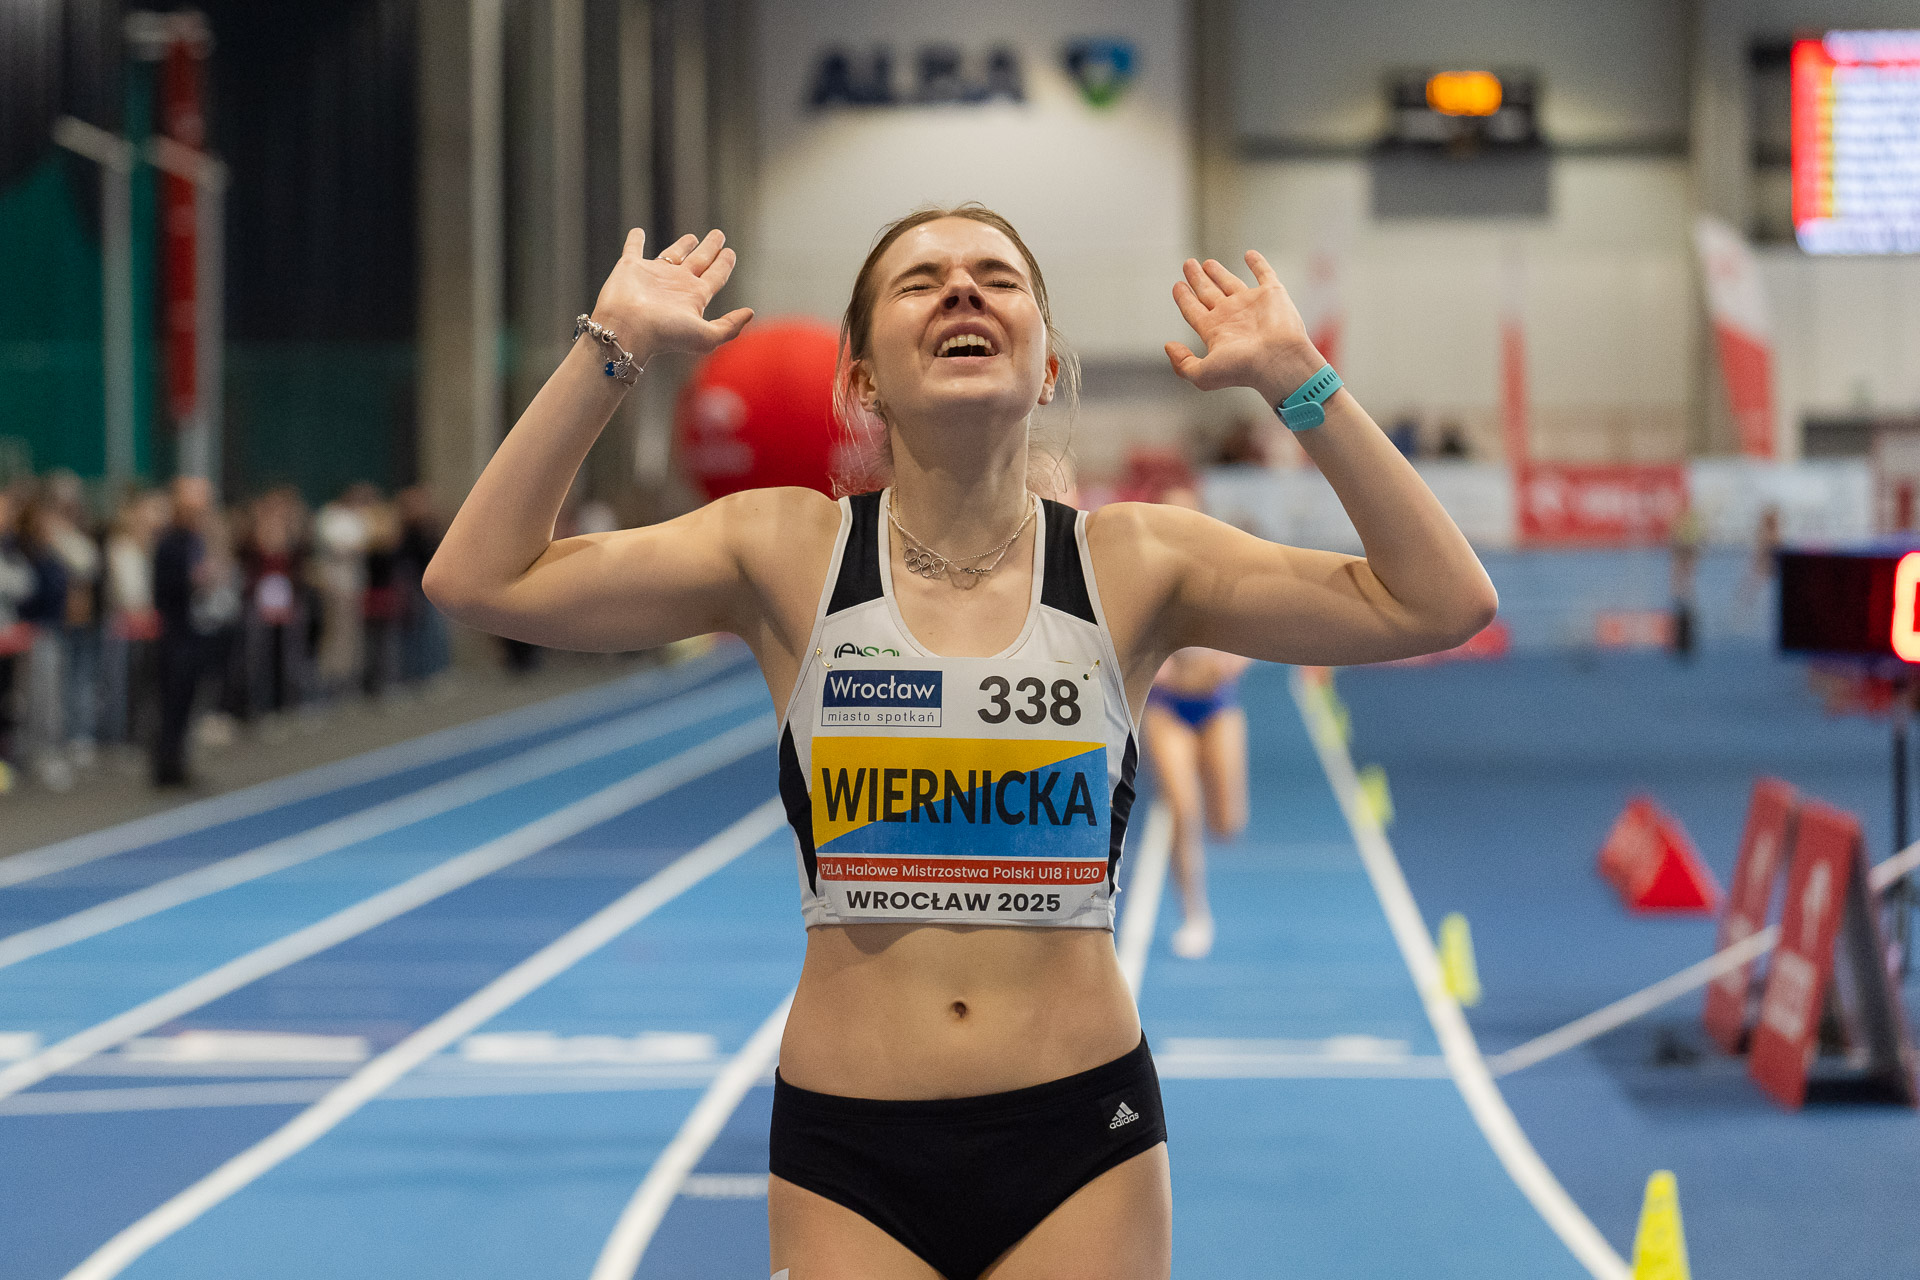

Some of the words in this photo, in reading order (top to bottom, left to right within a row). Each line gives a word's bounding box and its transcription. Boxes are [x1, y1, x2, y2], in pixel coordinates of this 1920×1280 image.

[830, 675, 935, 699] Wrocław
[977, 675, 1082, 726] 338
[828, 711, 870, 721] miasto
[877, 710, 934, 724] spotkań
[821, 767, 1098, 827] WIERNICKA
[821, 863, 843, 876] PZLA
[846, 863, 898, 877] Halowe
[902, 864, 988, 878] Mistrzostwa
[993, 866, 1034, 879] Polski
[1038, 867, 1062, 880] U18
[1066, 867, 1070, 880] i
[1074, 867, 1100, 880] U20
[846, 890, 991, 912] WROCŁAW
[997, 892, 1061, 912] 2025
[1109, 1112, 1139, 1129] adidas
